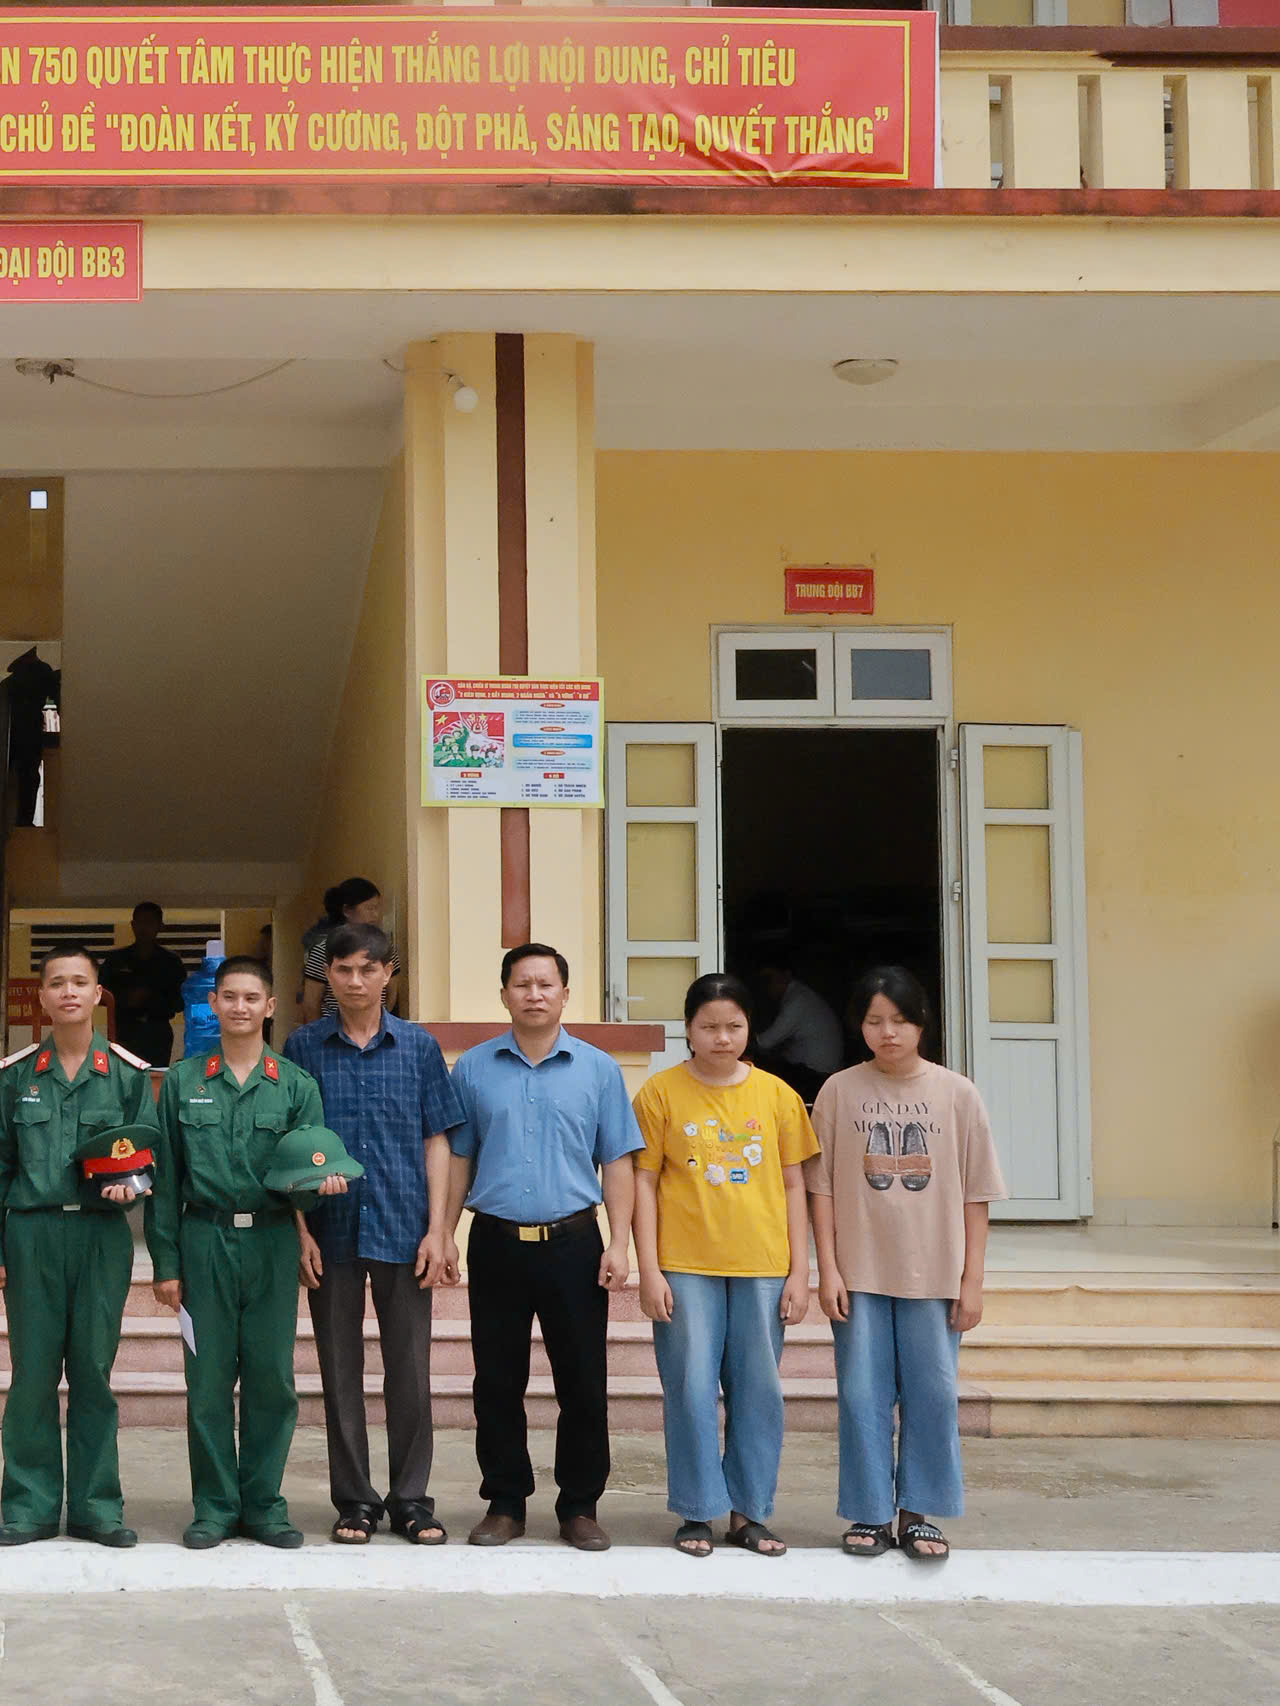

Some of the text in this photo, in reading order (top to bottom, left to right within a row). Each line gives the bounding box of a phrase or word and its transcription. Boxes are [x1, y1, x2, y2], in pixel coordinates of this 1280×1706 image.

[29, 46, 77, 85] 750
[86, 33, 168, 88] QUYẾT
[177, 38, 234, 84] TÂM
[243, 42, 312, 92] THỰC
[321, 38, 383, 92] HIỆN
[392, 31, 479, 84] THẮNG
[489, 41, 529, 92] LỢI
[539, 37, 584, 92] NỘI
[595, 46, 676, 88] DUNG,
[685, 34, 729, 85] CHỈ
[738, 39, 795, 87] TIÊU
[0, 100, 52, 153] CHỦ
[62, 101, 95, 152] ĐỀ
[106, 105, 194, 152] "ĐOÀN
[203, 100, 256, 156] KẾT,
[265, 100, 299, 152] KỶ
[308, 109, 408, 156] CƯƠNG,
[416, 104, 466, 159] ĐỘT
[476, 105, 537, 156] PHÁ,
[546, 105, 620, 152] SÁNG
[628, 112, 685, 160] TẠO,
[694, 103, 776, 155] QUYẾT
[37, 240, 75, 286] ĐỘI
[81, 246, 125, 278] BB3
[795, 581, 864, 601] TRUNG ĐỘI BB7
[862, 1102, 928, 1114] GINDAY
[854, 1120, 941, 1134] MONNG
